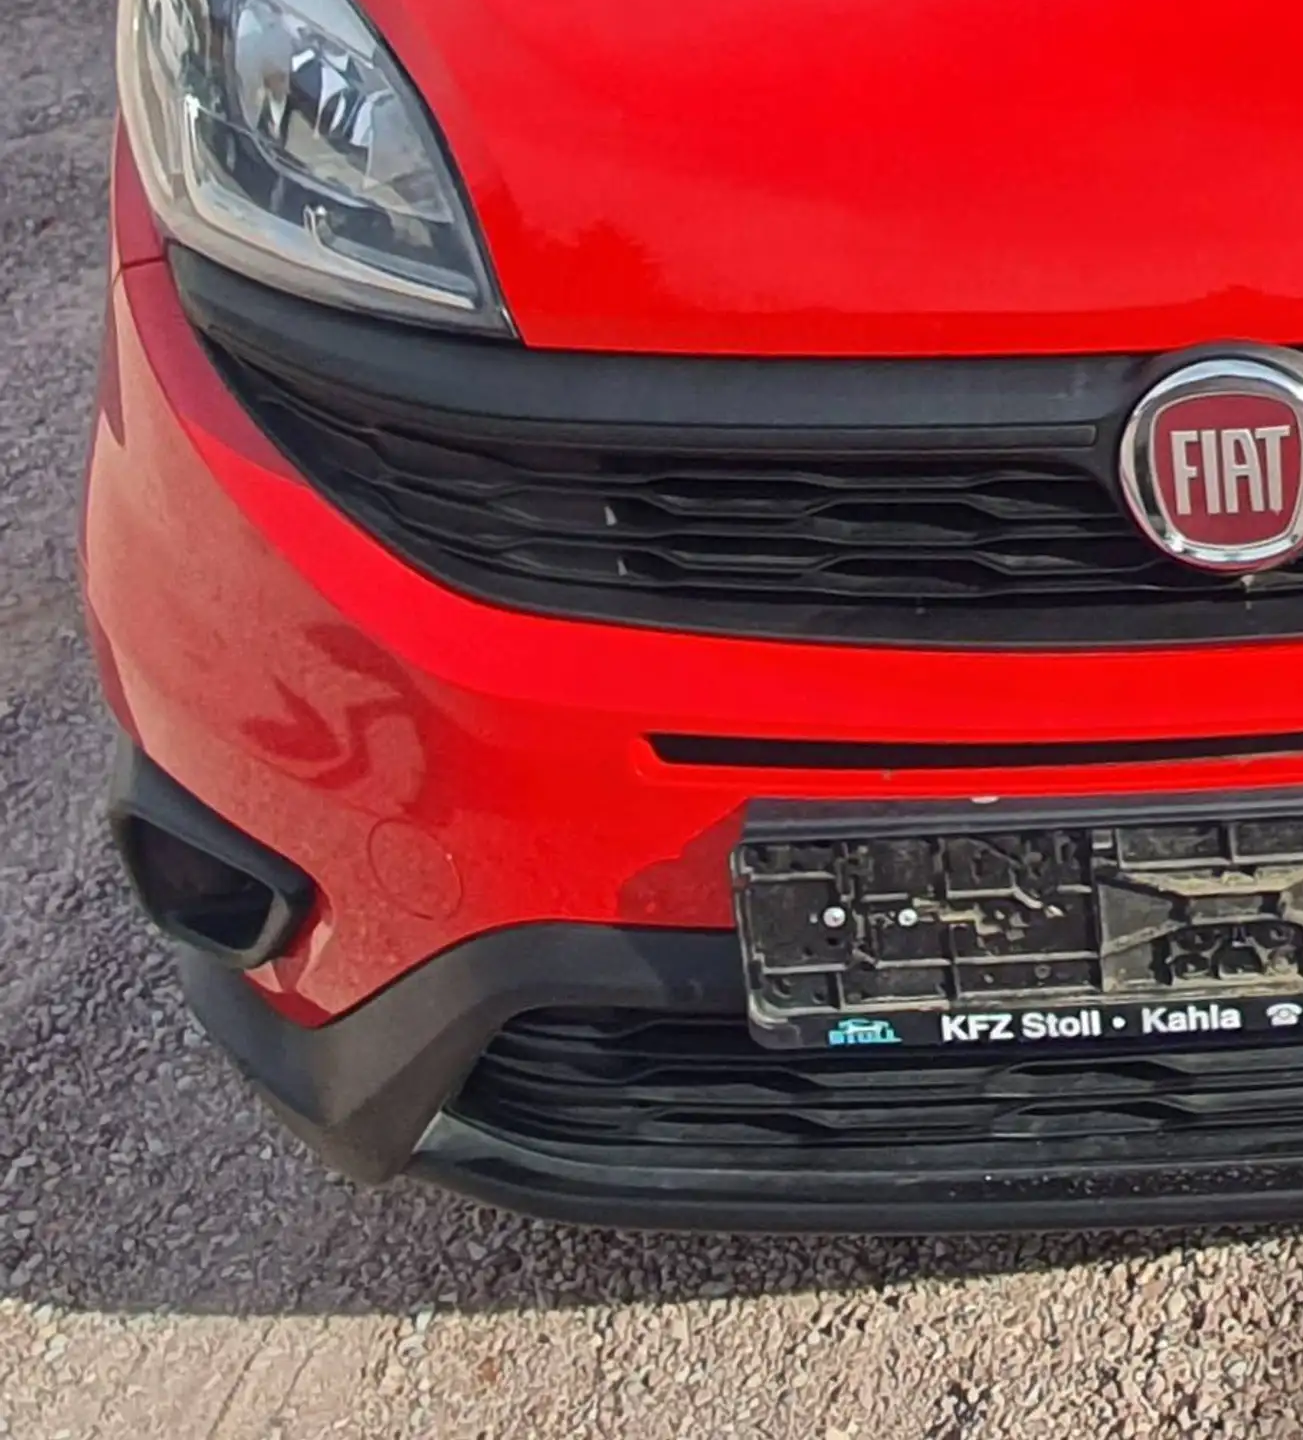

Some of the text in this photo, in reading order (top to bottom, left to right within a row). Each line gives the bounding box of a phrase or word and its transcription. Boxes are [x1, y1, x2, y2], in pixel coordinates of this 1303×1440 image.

[1170, 425, 1291, 516] FIAT
[940, 1013, 1014, 1042] KFZ
[1021, 1009, 1102, 1040] Stoll
[1141, 1004, 1242, 1034] Kahla
